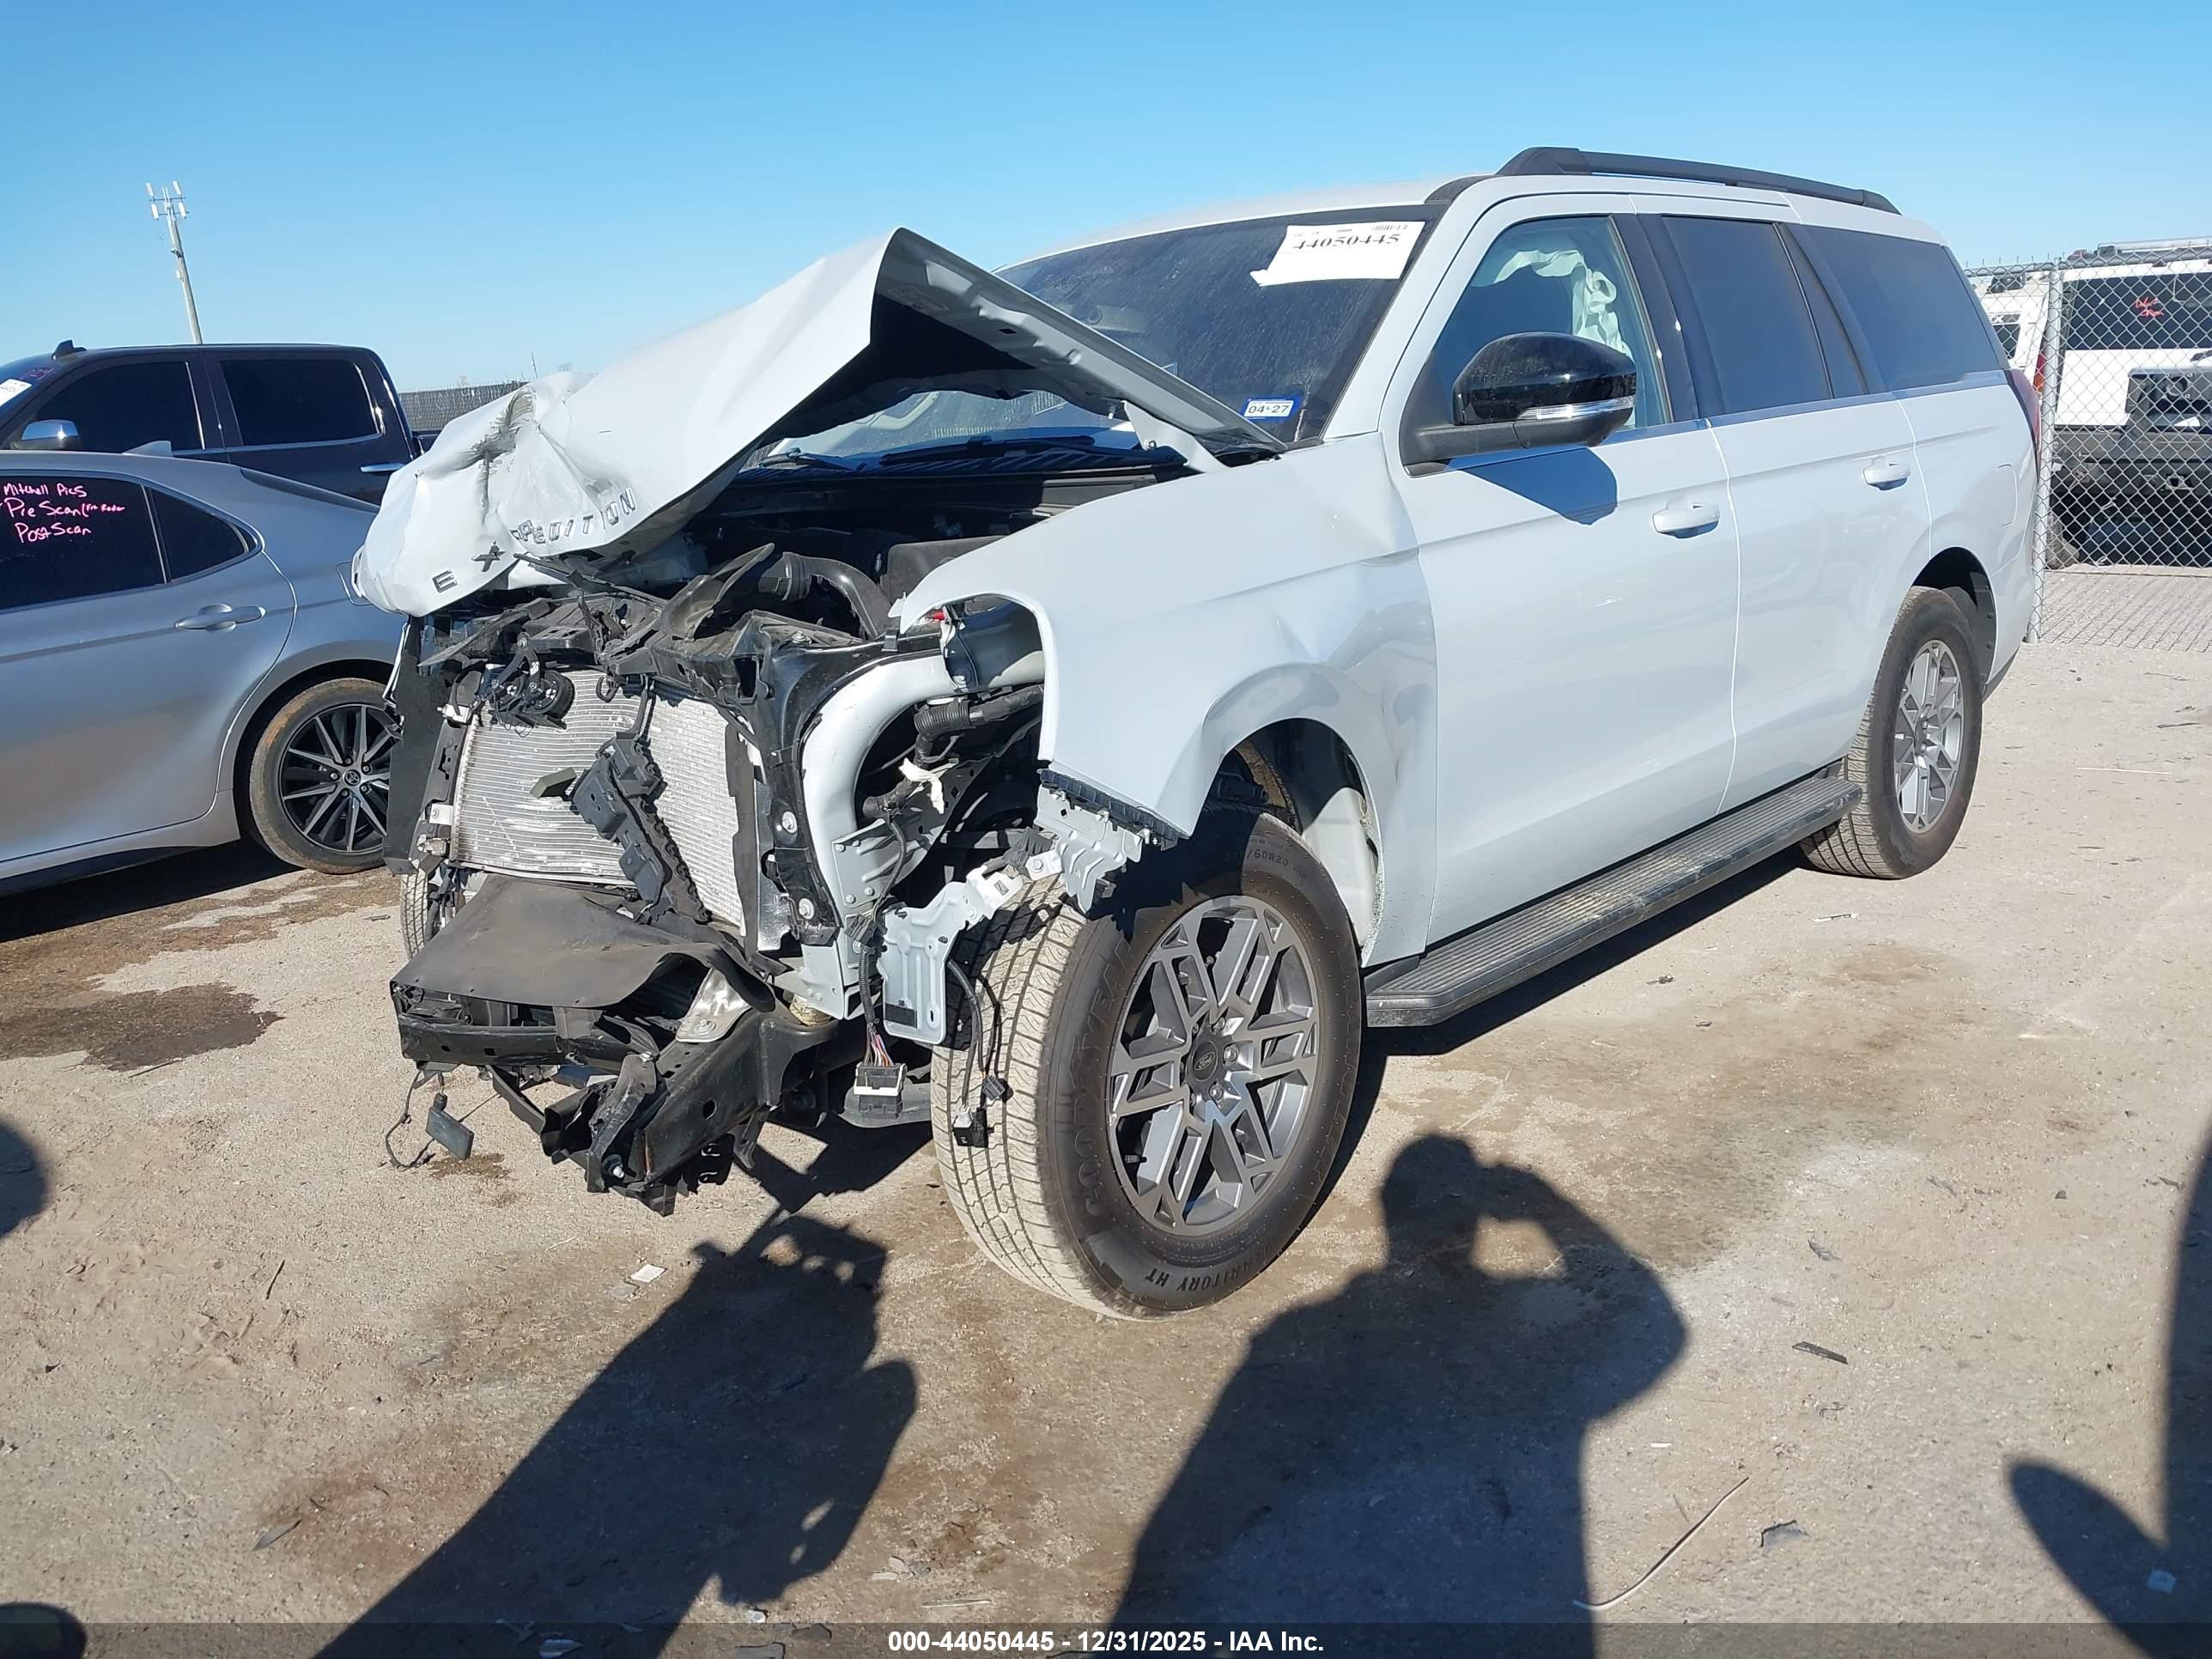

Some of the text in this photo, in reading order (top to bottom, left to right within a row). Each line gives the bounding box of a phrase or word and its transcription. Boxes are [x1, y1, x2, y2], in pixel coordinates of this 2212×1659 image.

[1292, 234, 1401, 250] 44050445
[1270, 404, 1291, 413] 27
[3, 483, 49, 496] Mitchell
[3, 496, 37, 519] Pre
[15, 521, 92, 544] Post Scan
